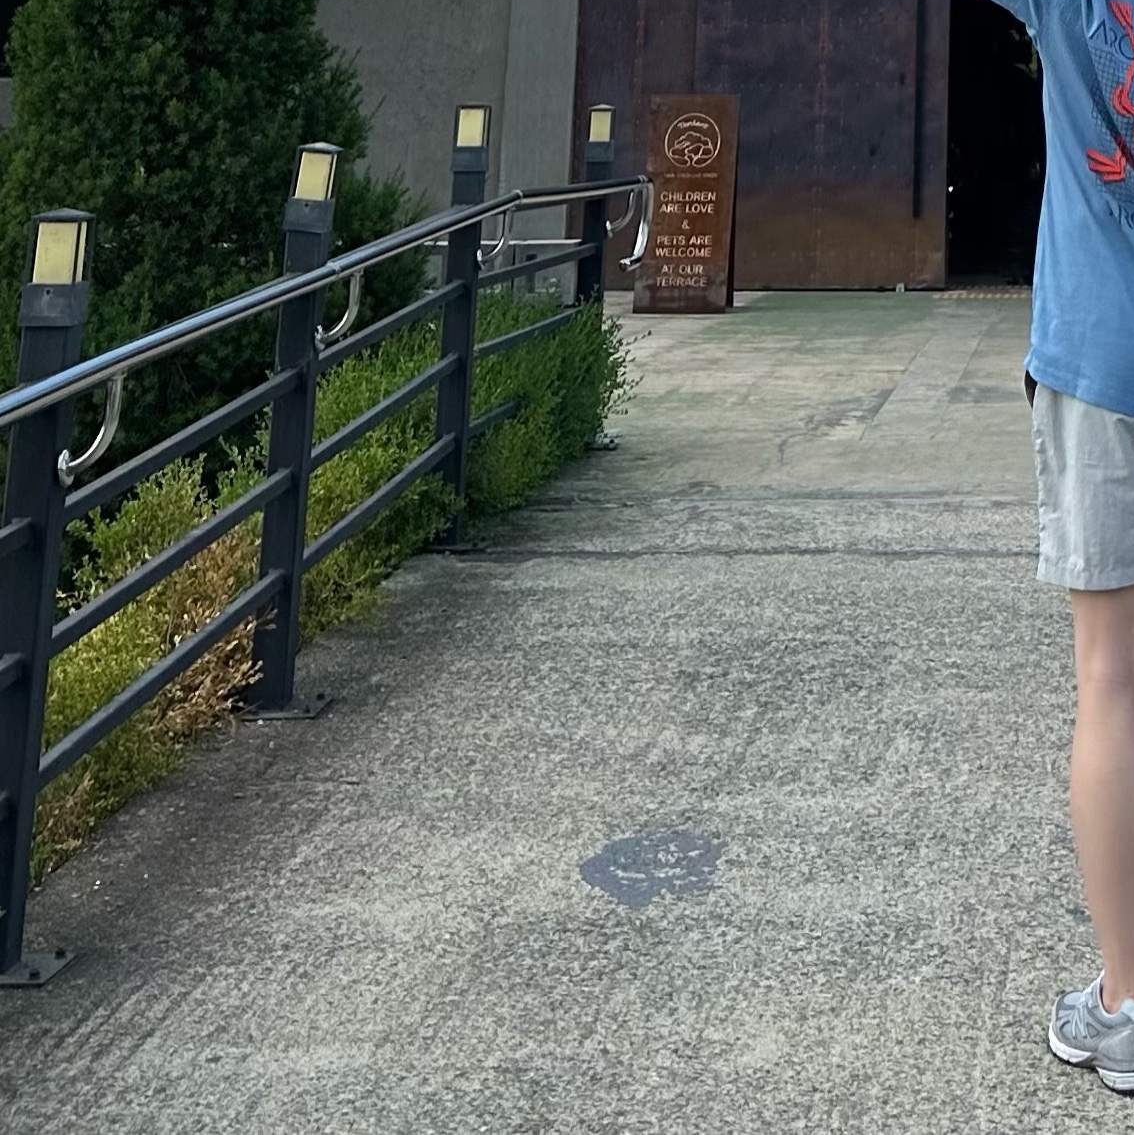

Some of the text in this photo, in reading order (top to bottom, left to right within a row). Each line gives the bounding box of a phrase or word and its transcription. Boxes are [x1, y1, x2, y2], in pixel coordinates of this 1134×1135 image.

[660, 191, 716, 202] CHILDREN
[659, 203, 715, 214] ARE LOVE
[681, 218, 690, 230] &
[656, 235, 712, 246] PETS ARE
[655, 247, 712, 258] WELCOME
[661, 264, 704, 275] AT OUR
[656, 276, 708, 287] TERRACE
